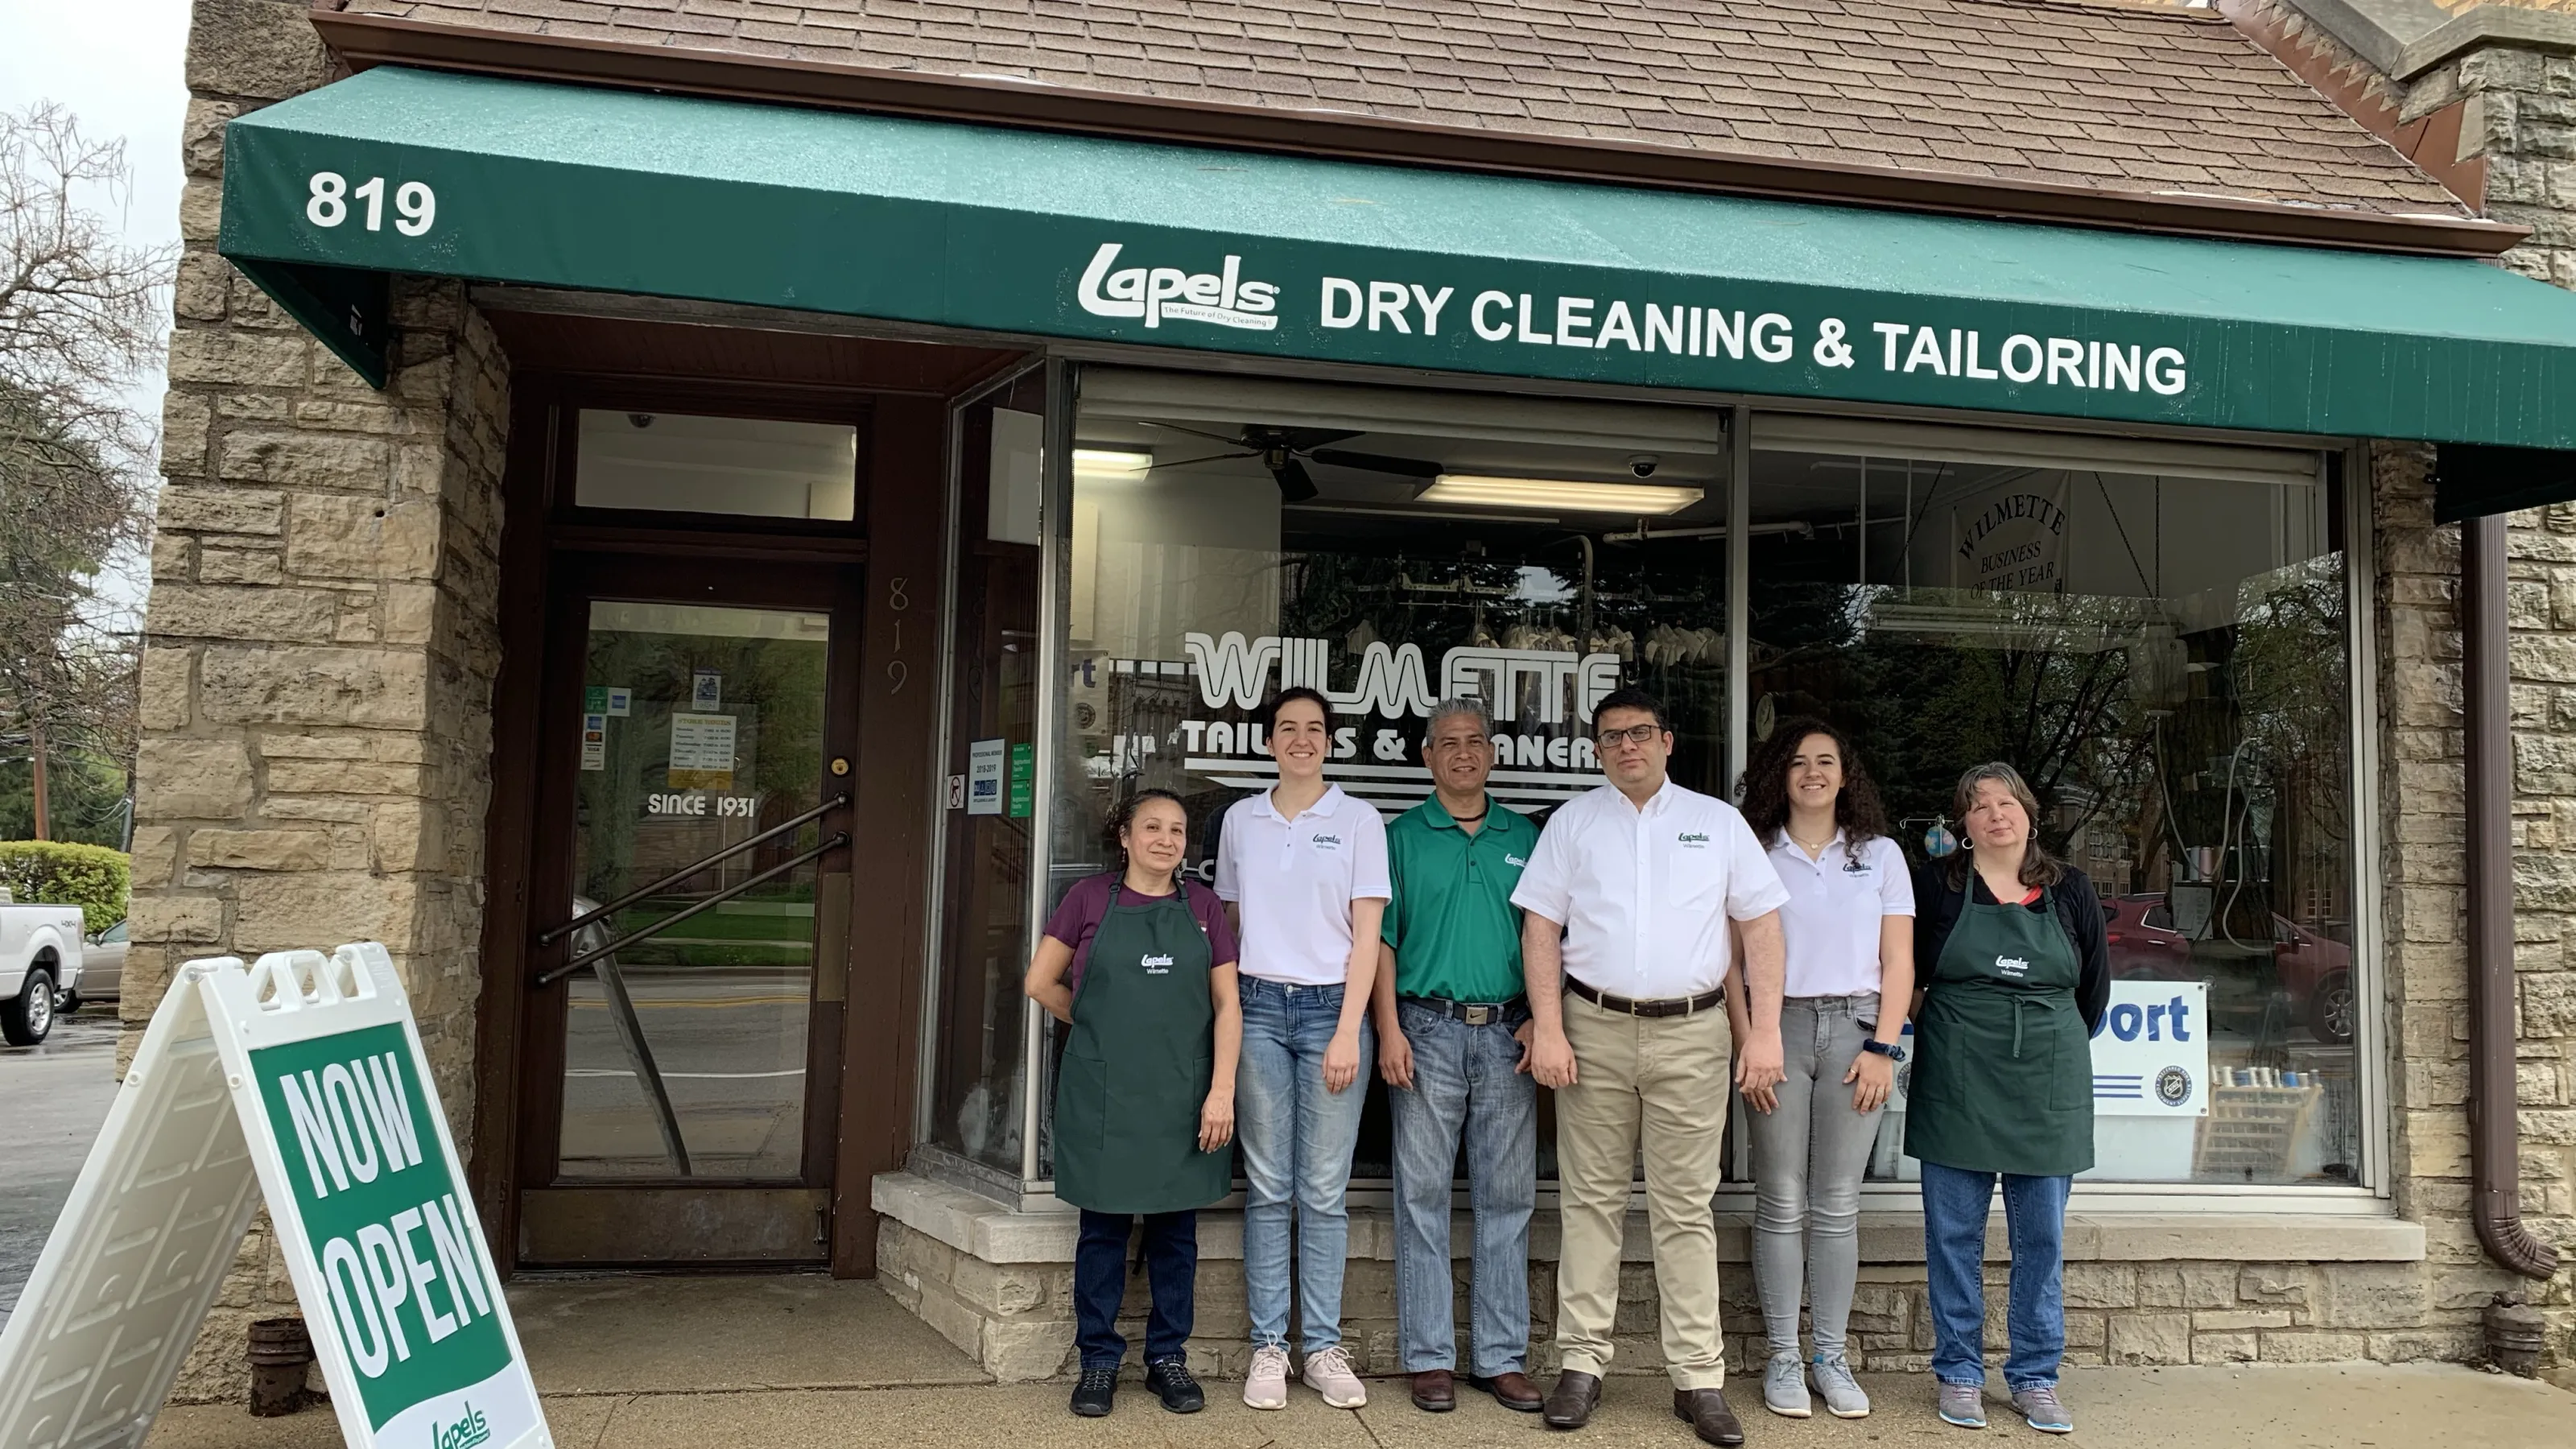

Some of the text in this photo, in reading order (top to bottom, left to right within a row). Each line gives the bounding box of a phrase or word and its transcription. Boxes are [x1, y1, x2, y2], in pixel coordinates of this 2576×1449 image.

[306, 171, 436, 237] 819
[1077, 242, 1277, 328] Lapels
[1181, 308, 1206, 316] Future
[1217, 312, 1232, 323] Dry
[1232, 316, 1267, 327] Cleaning
[1321, 277, 2186, 395] DRY CLEANING & TAILORING
[1959, 493, 2066, 560] WILMETTE
[1980, 540, 2041, 574] BUSINESS
[1970, 561, 2055, 600] OF THE YEAR
[1182, 720, 1356, 759] TAILS
[1373, 729, 1407, 761] &
[648, 794, 754, 818] SINCE 1931
[1678, 832, 1709, 843] Lapels
[1141, 953, 1174, 968] Lapels
[1996, 955, 2029, 970] Lapels
[2000, 968, 2024, 978] Wilmette
[279, 1051, 423, 1199] NOW
[323, 1193, 490, 1378] OPEN
